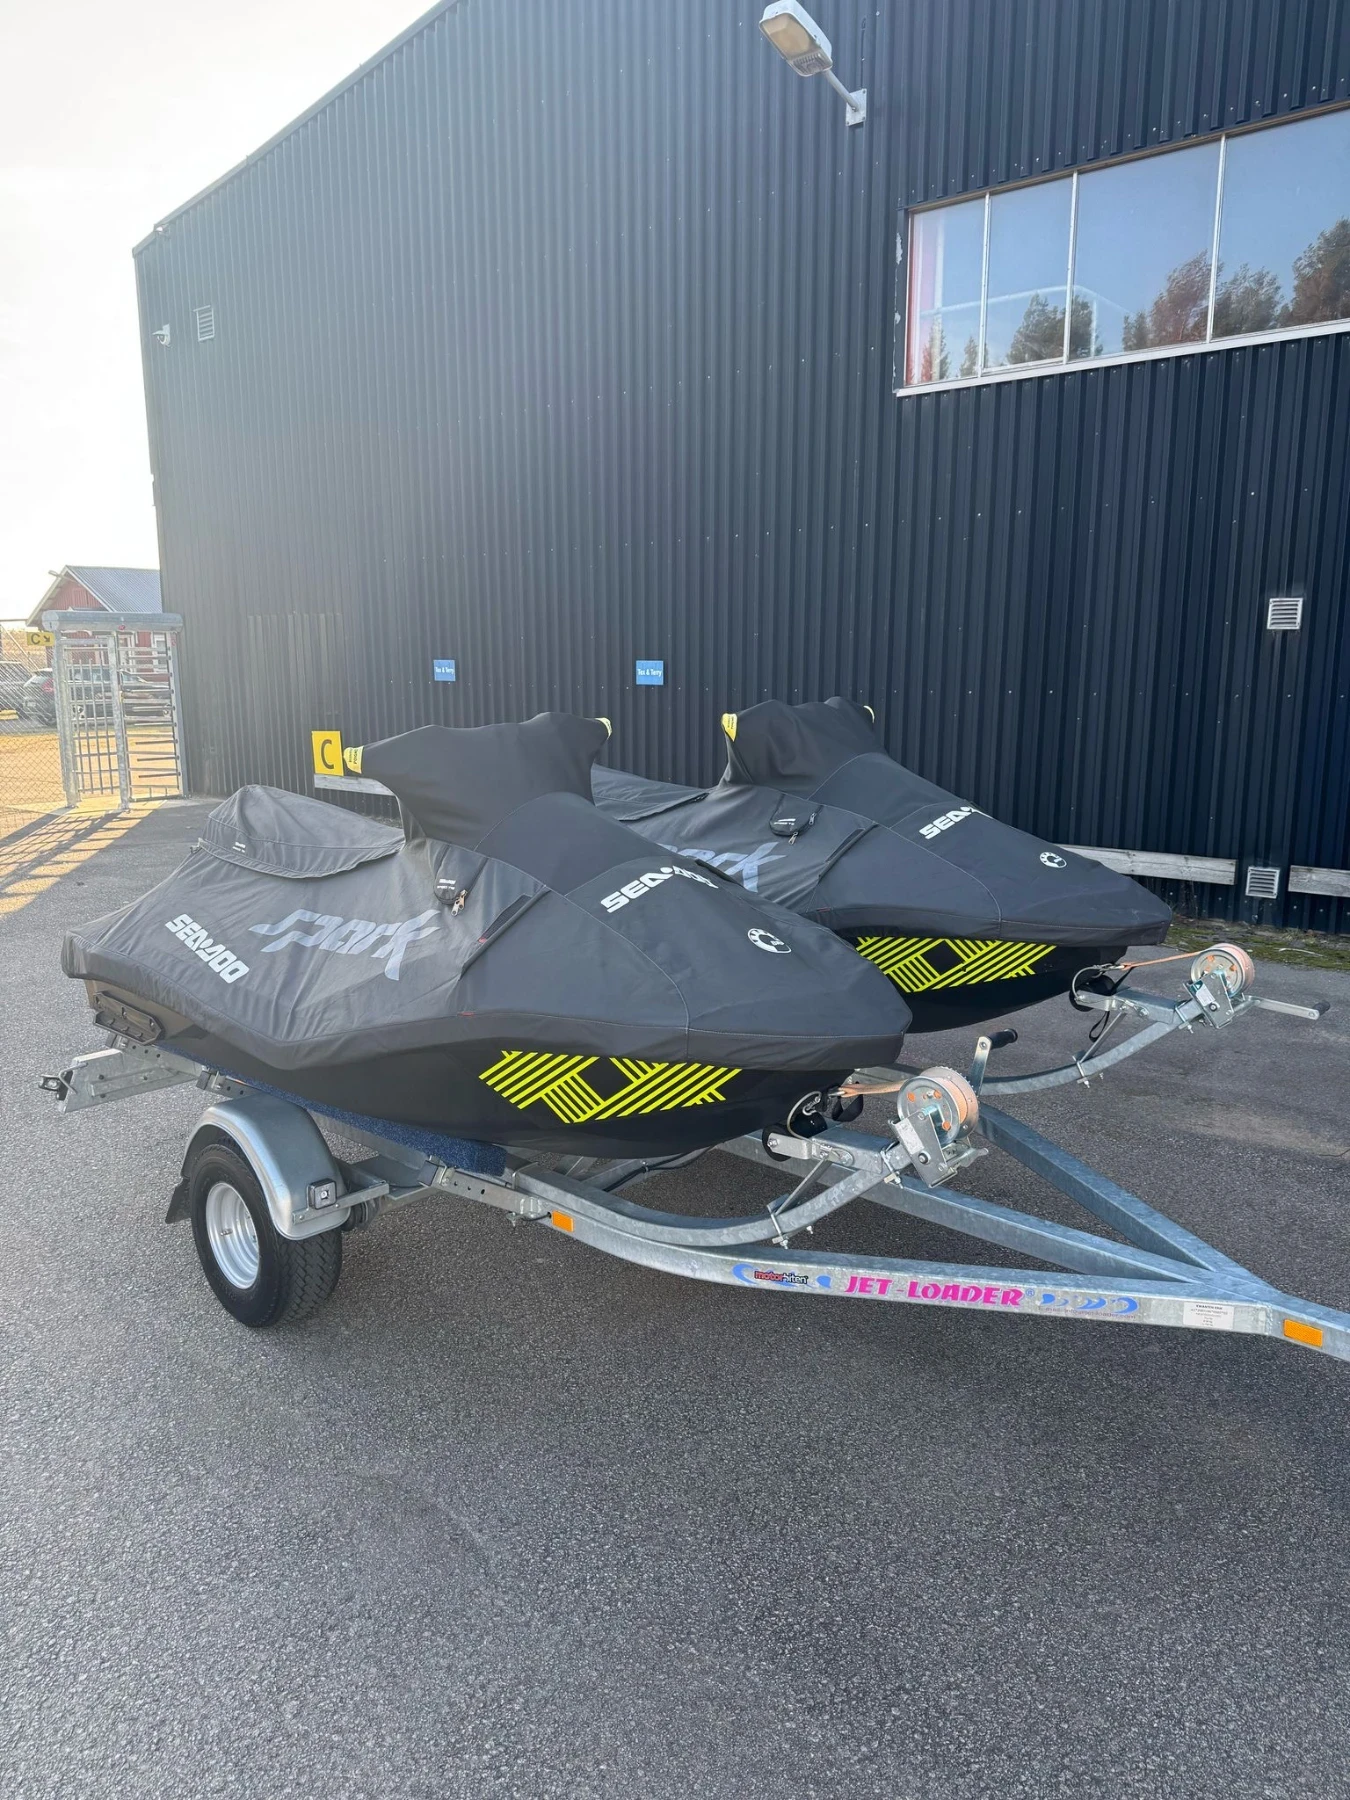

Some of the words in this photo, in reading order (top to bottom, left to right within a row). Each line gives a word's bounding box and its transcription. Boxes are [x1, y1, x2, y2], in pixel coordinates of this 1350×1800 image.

[31, 633, 41, 645] C
[651, 668, 662, 678] Terry
[321, 739, 335, 770] C
